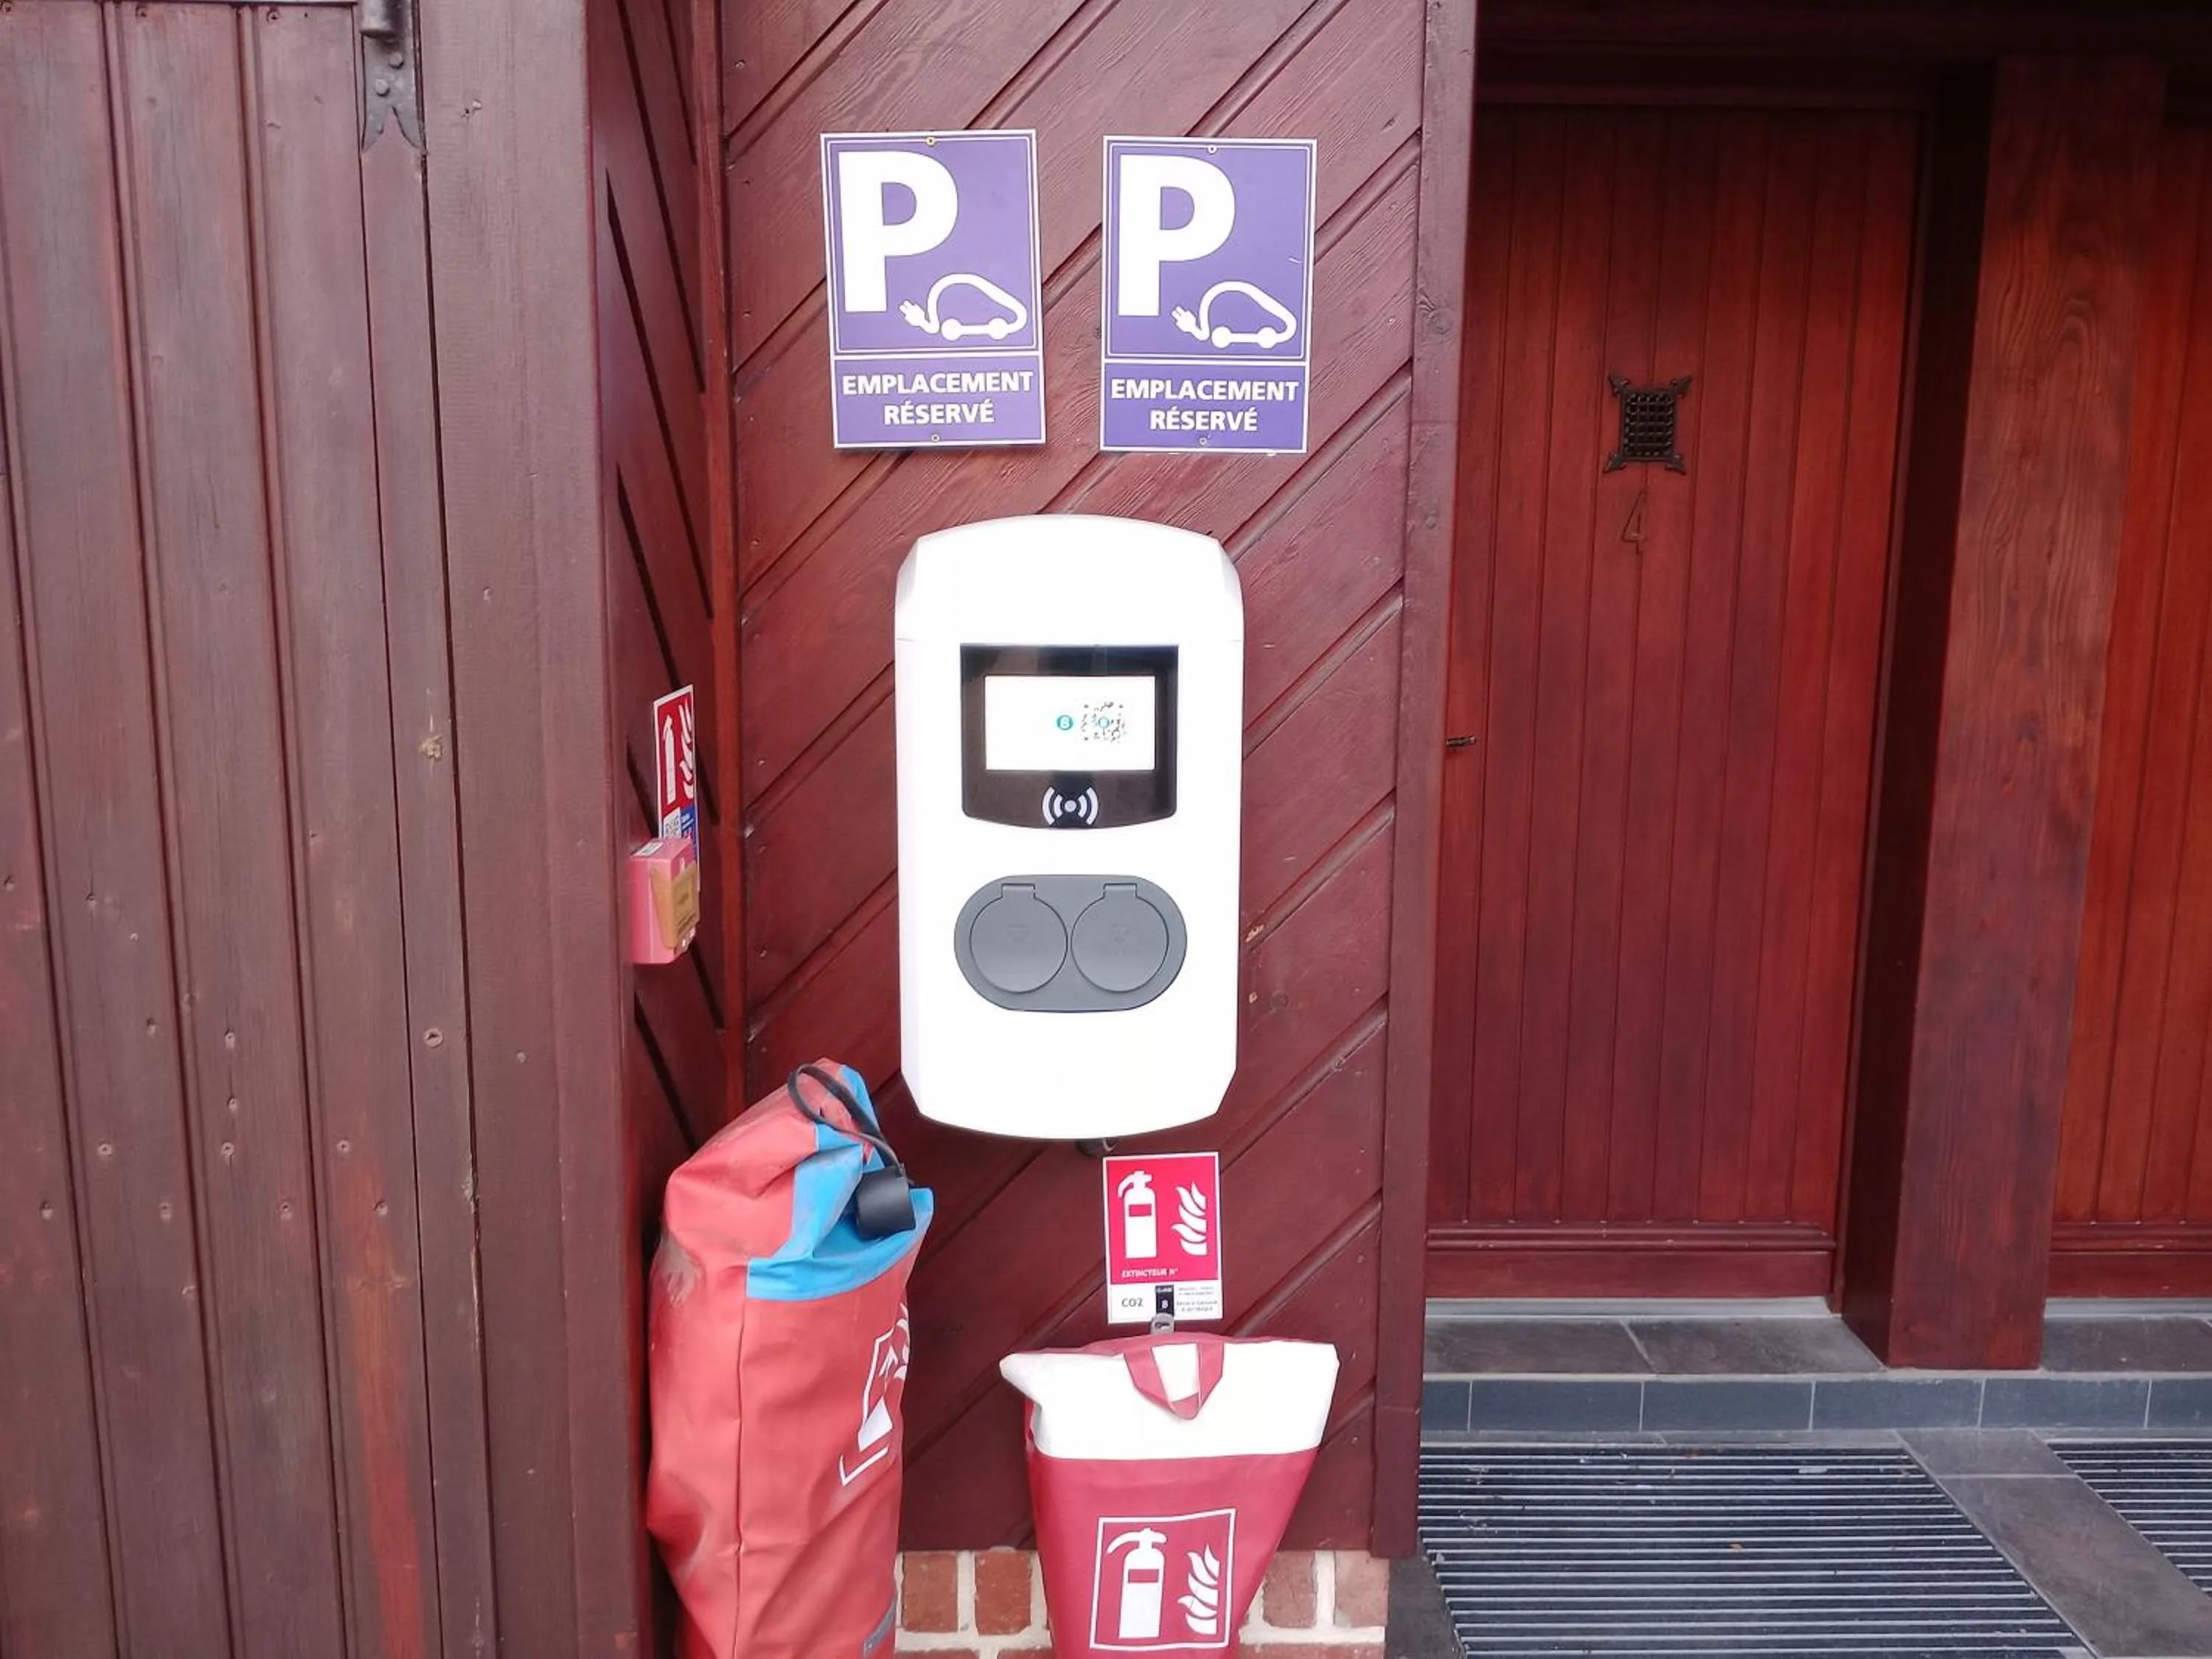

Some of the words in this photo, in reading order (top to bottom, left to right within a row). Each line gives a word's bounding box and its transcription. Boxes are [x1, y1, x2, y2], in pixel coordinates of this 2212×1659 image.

[839, 151, 958, 313] P
[1119, 154, 1235, 316] P
[842, 372, 1034, 395] EMPLACEMENT
[1110, 378, 1299, 401] EMPLACEMENT
[884, 398, 995, 425] RÉSERVÉ
[1150, 406, 1258, 432] RÉSERVÉ
[1121, 1268, 1167, 1278] EXTINCTEUR
[1121, 1297, 1143, 1307] CO2
